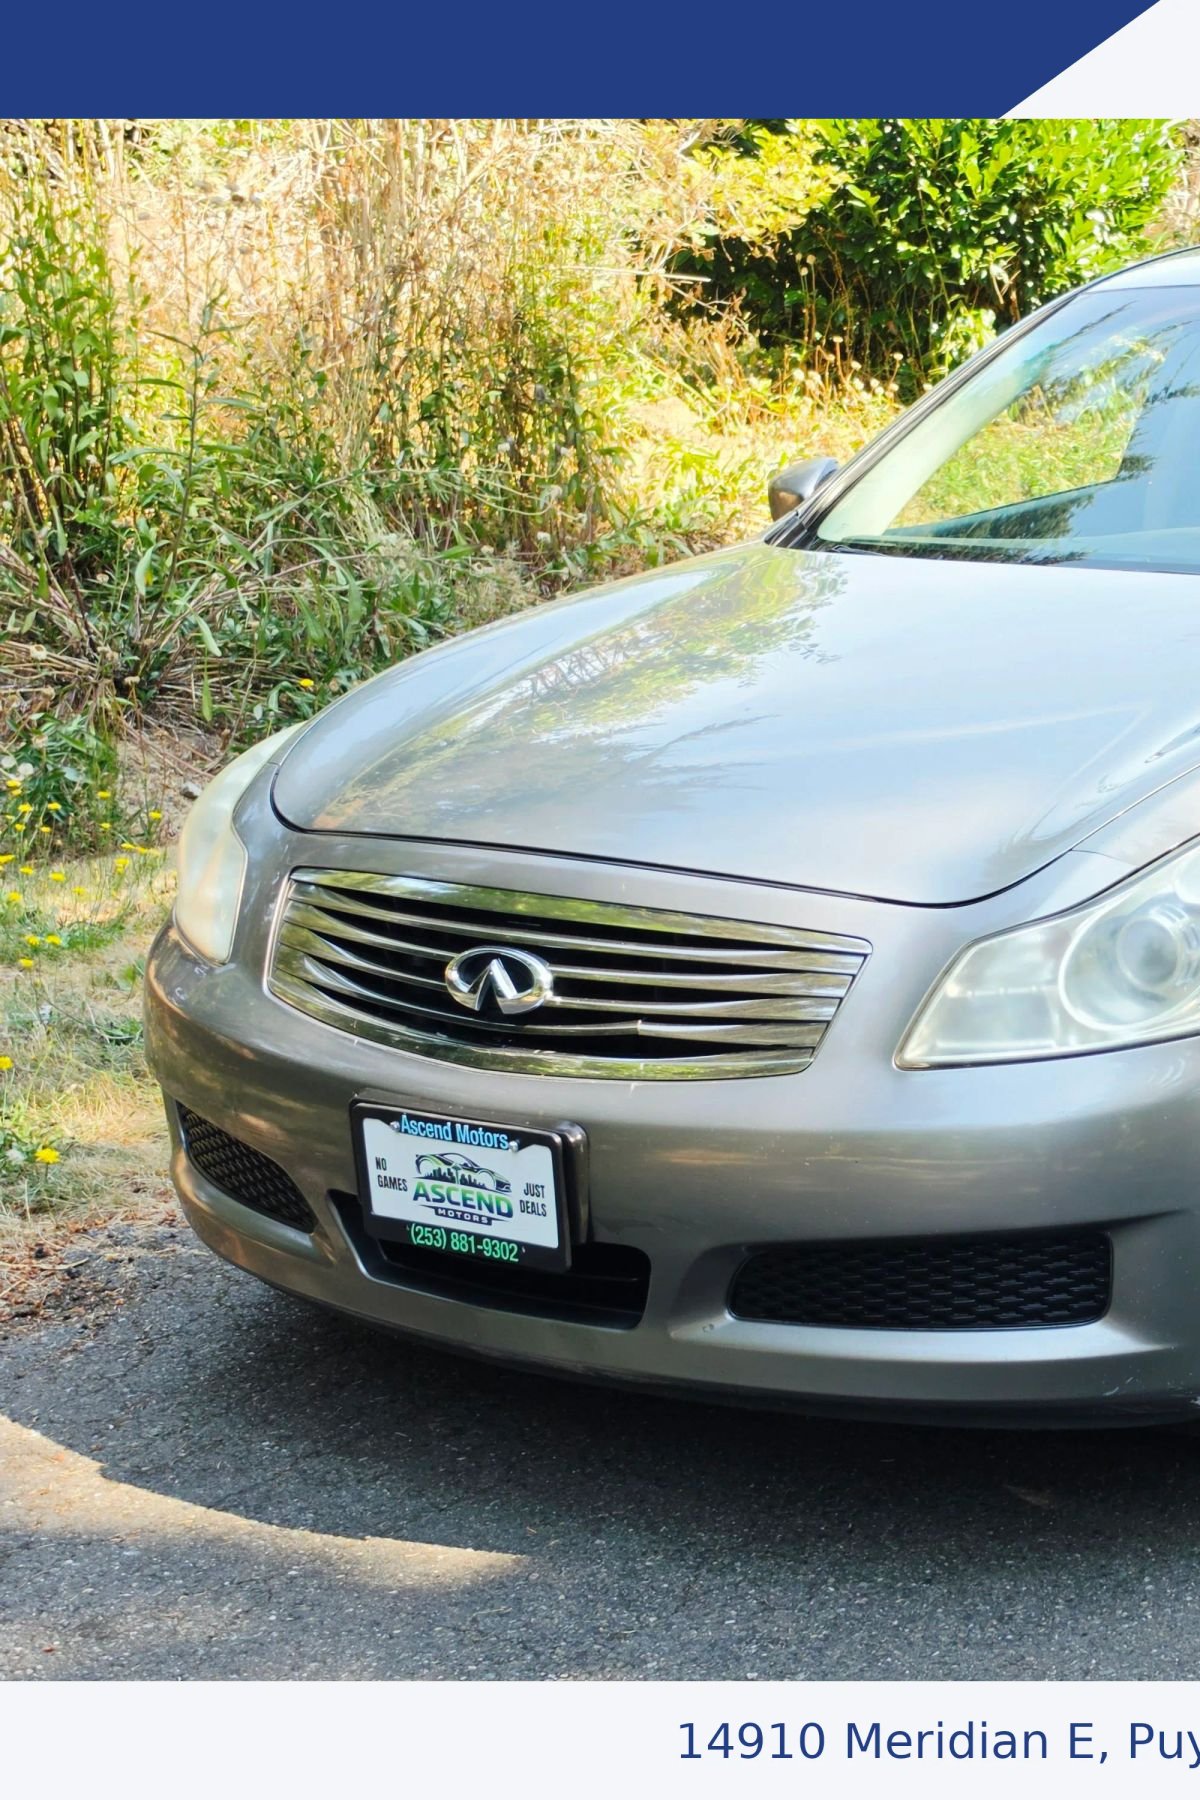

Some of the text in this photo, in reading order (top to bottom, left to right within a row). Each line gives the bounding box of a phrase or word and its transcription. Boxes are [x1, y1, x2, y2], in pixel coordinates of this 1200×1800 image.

[400, 1113, 510, 1150] Ascend Motors
[375, 1156, 387, 1172] NO
[377, 1175, 408, 1192] GAMES
[523, 1182, 546, 1199] JUST
[412, 1181, 514, 1219] ASCEND
[519, 1199, 547, 1217] DEALS
[438, 1207, 489, 1225] MOTORS
[410, 1223, 519, 1263] (253) 881-9302
